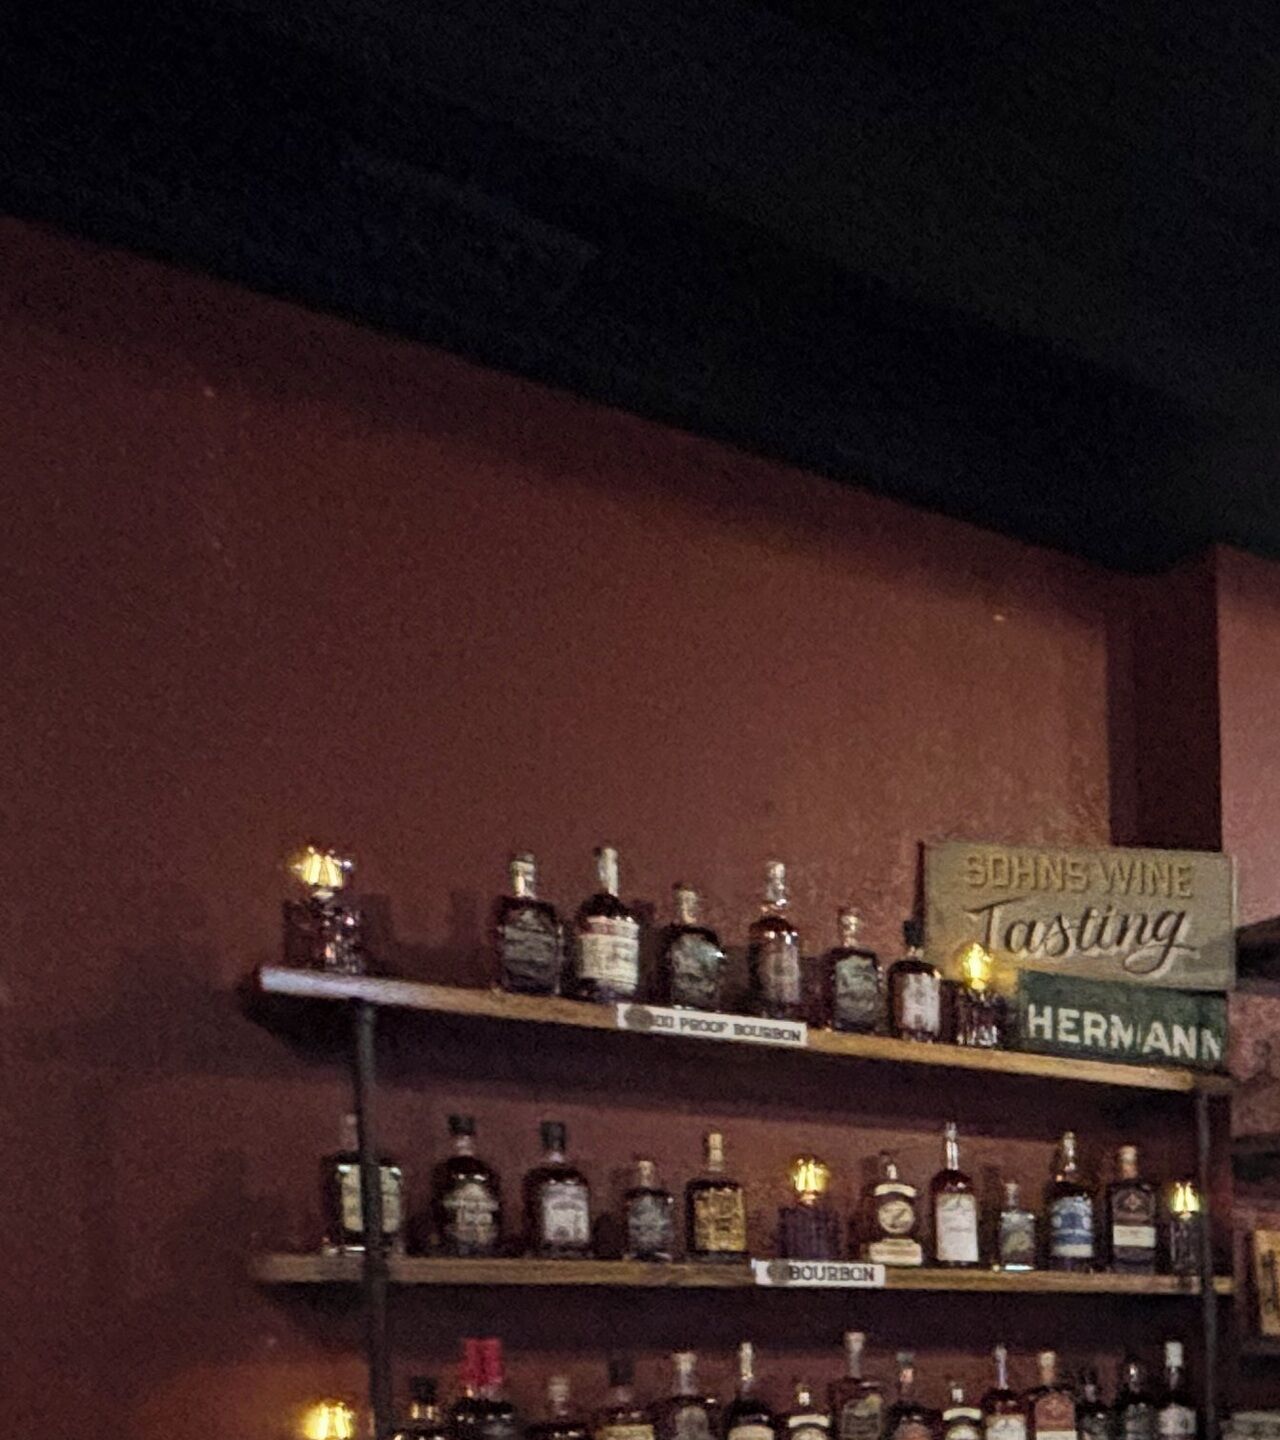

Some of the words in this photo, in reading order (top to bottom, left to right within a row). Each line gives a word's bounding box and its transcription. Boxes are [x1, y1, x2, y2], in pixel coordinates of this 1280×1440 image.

[1104, 862, 1194, 899] WINE
[965, 897, 1196, 976] Tasting
[679, 1017, 728, 1033] PROOF
[733, 1023, 801, 1041] BOURBON
[1027, 1004, 1221, 1060] HERMANN
[789, 1265, 875, 1281] BOURBON
